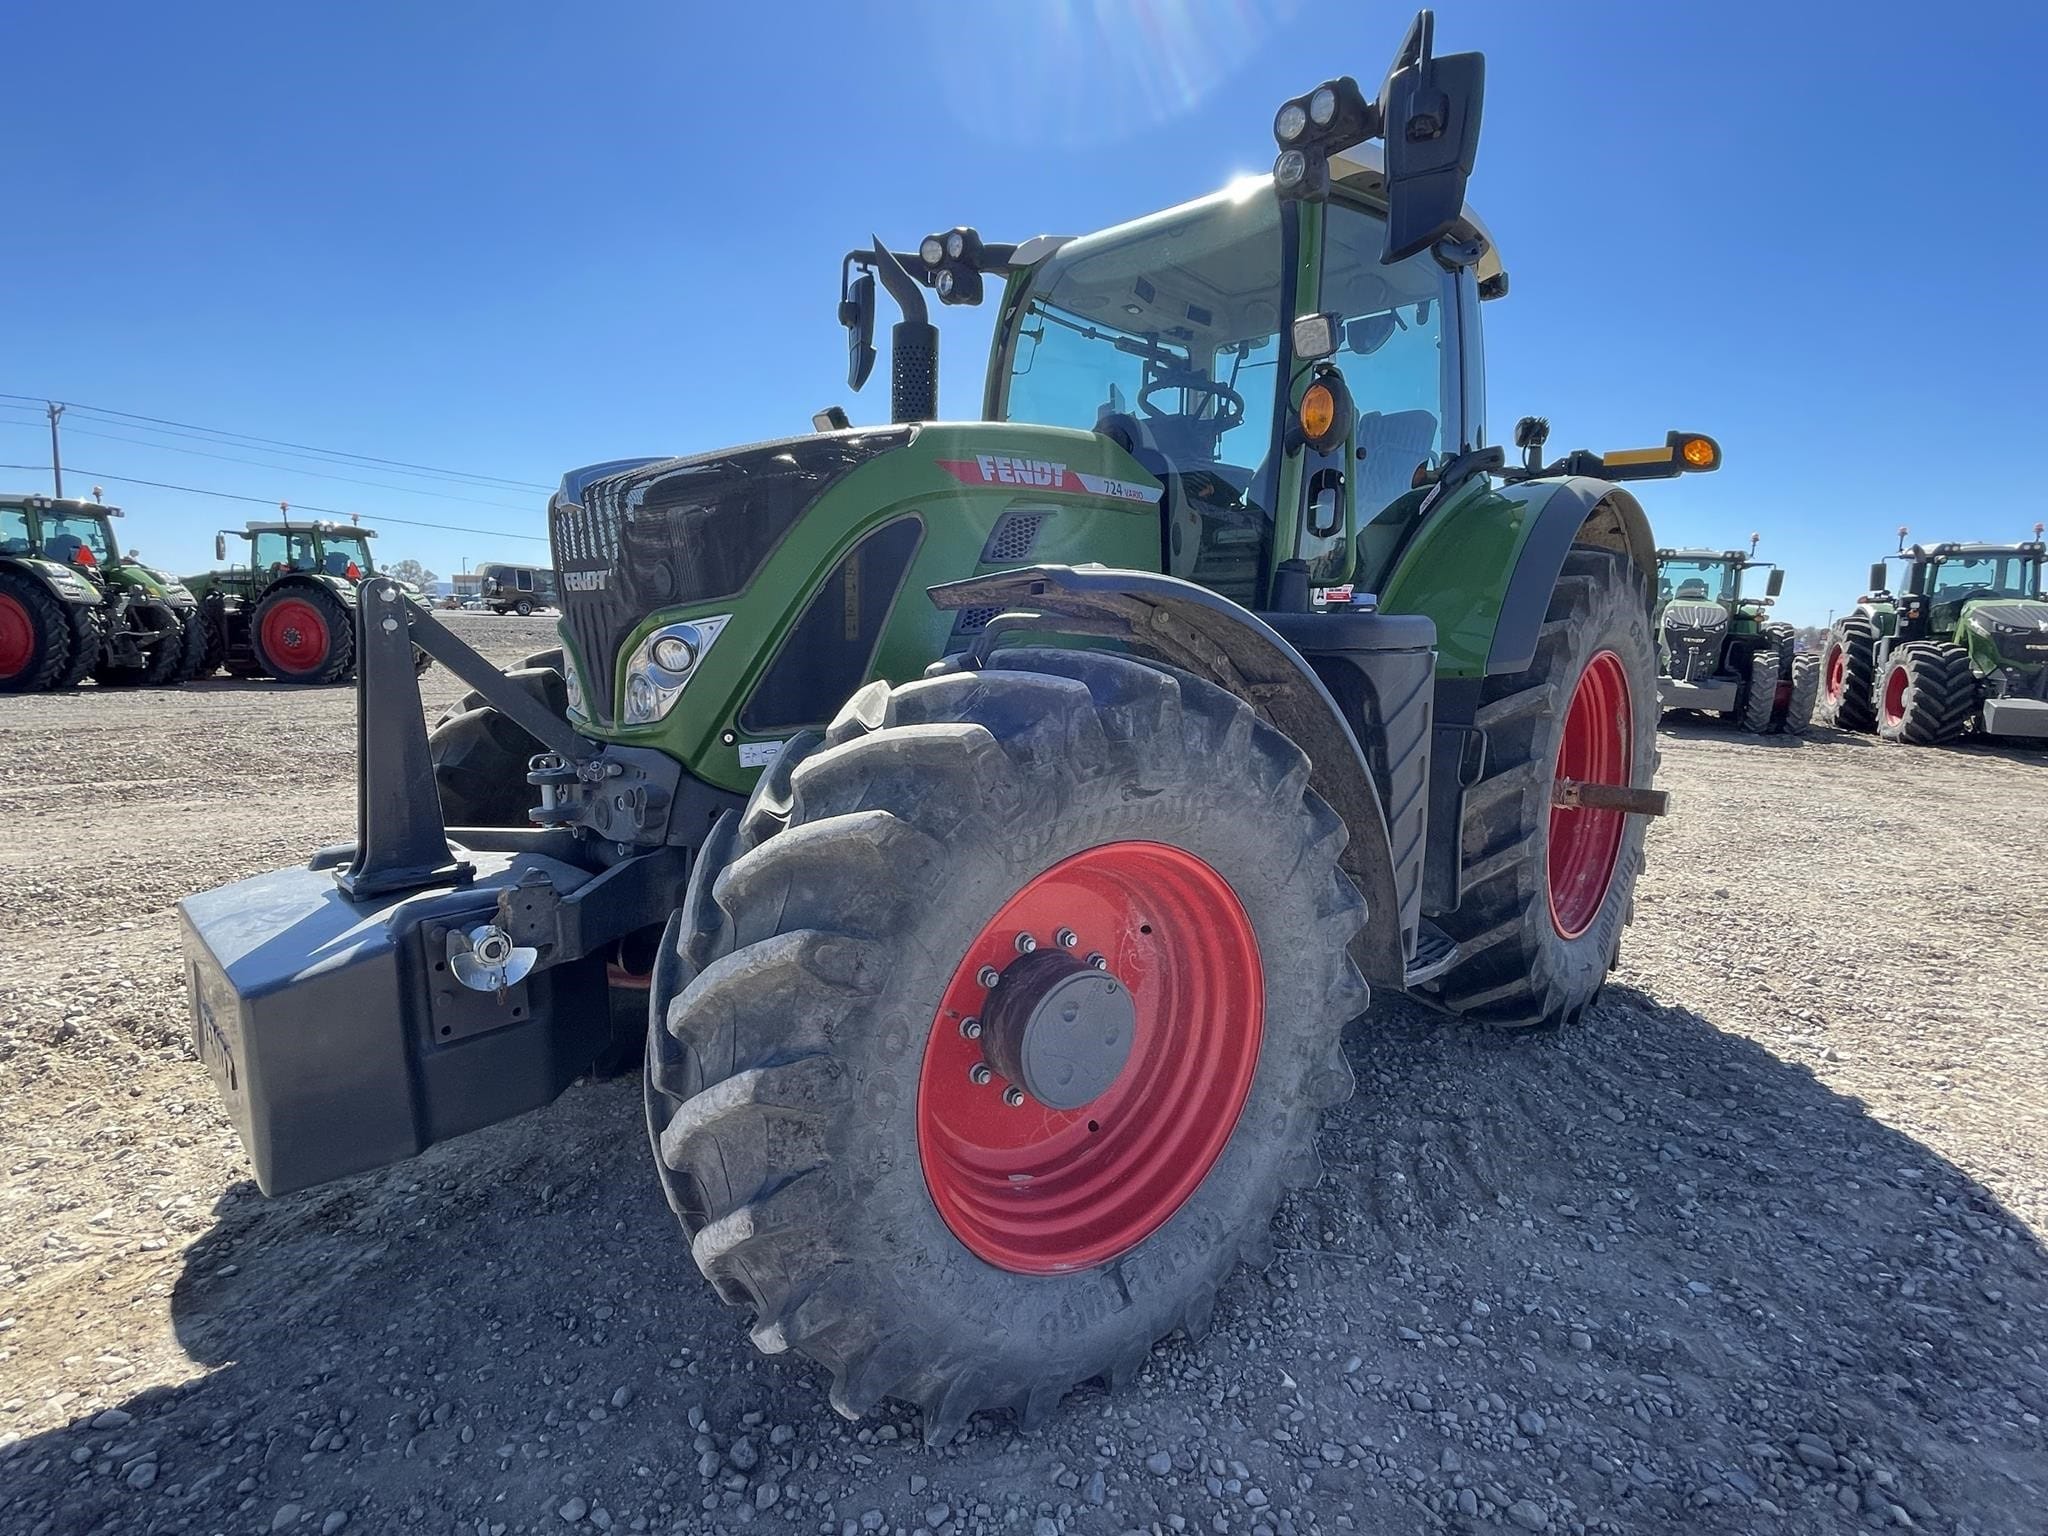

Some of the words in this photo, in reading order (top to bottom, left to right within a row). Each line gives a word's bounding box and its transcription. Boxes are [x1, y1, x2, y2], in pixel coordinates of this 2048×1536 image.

[976, 454, 1067, 487] FENDT
[1104, 480, 1122, 496] 724
[1124, 488, 1144, 499] VARIO
[564, 570, 608, 591] FENDT
